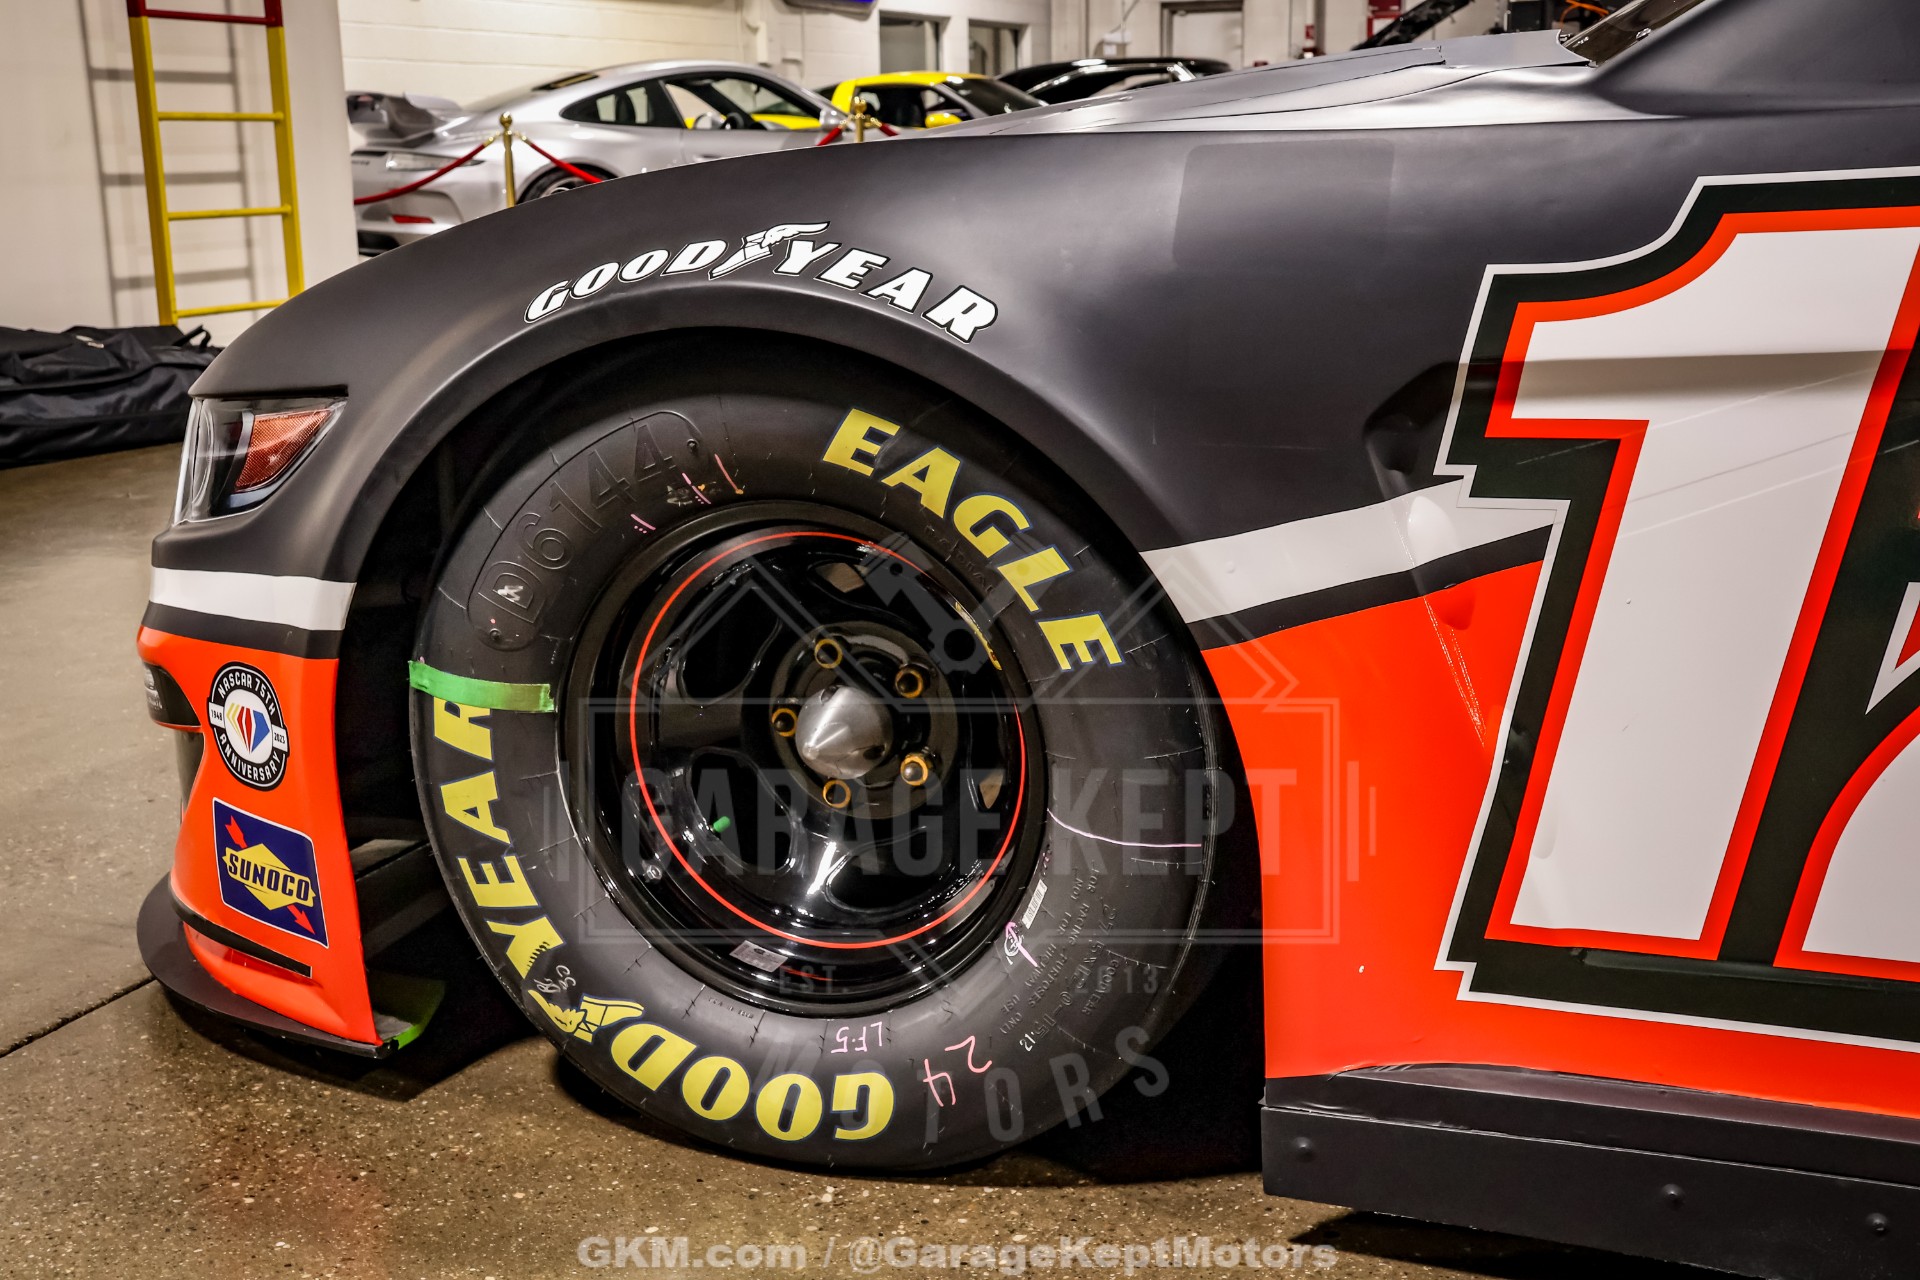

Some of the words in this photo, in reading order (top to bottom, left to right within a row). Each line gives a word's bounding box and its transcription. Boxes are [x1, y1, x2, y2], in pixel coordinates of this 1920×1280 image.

[821, 406, 1124, 673] EAGLE
[210, 708, 223, 721] 1948
[218, 672, 253, 699] NASCAR
[254, 677, 276, 716] 75TH
[219, 733, 281, 781] ANNIVERSARY
[273, 732, 286, 744] 2023
[228, 853, 311, 903] SUNOCO
